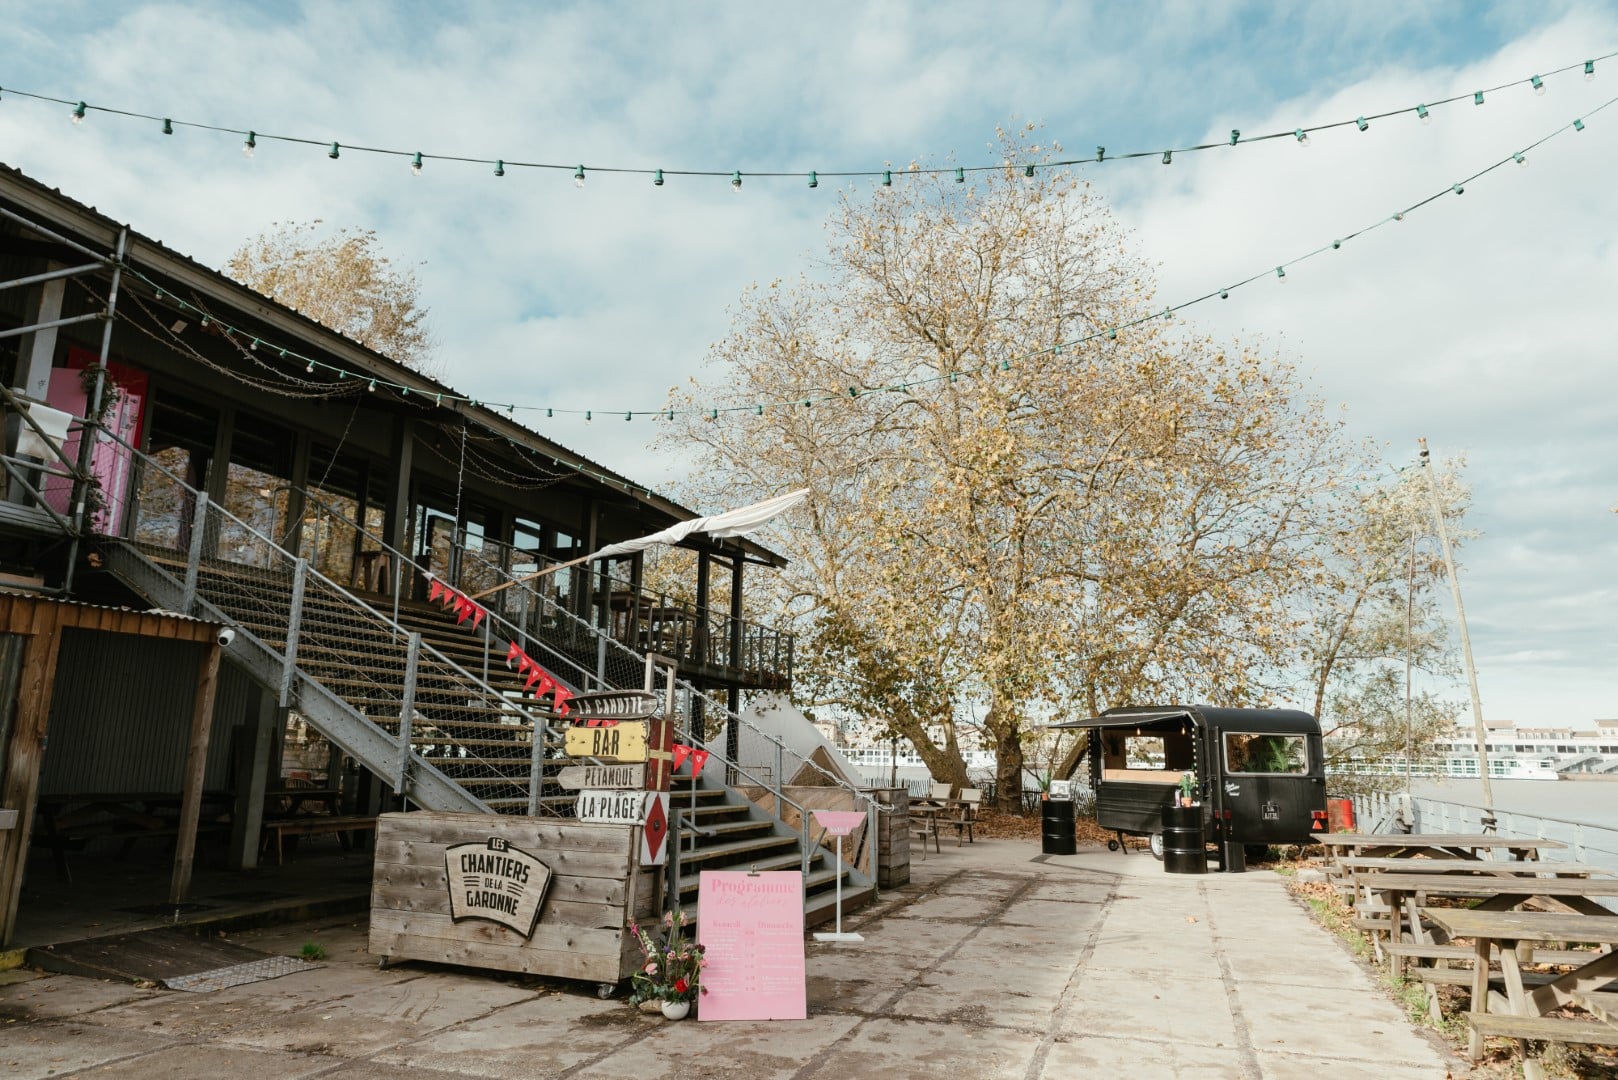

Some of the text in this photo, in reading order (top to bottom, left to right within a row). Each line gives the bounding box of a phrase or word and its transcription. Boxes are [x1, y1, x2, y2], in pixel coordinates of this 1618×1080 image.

[576, 696, 643, 715] LA CAHUTTE
[592, 729, 620, 756] BAR
[582, 796, 636, 819] LA PLAGE
[492, 838, 505, 850] LES
[461, 853, 531, 884] CHANTIERS
[484, 877, 503, 891] DE LA
[711, 878, 796, 896] Programme
[466, 890, 519, 917] GARONNE
